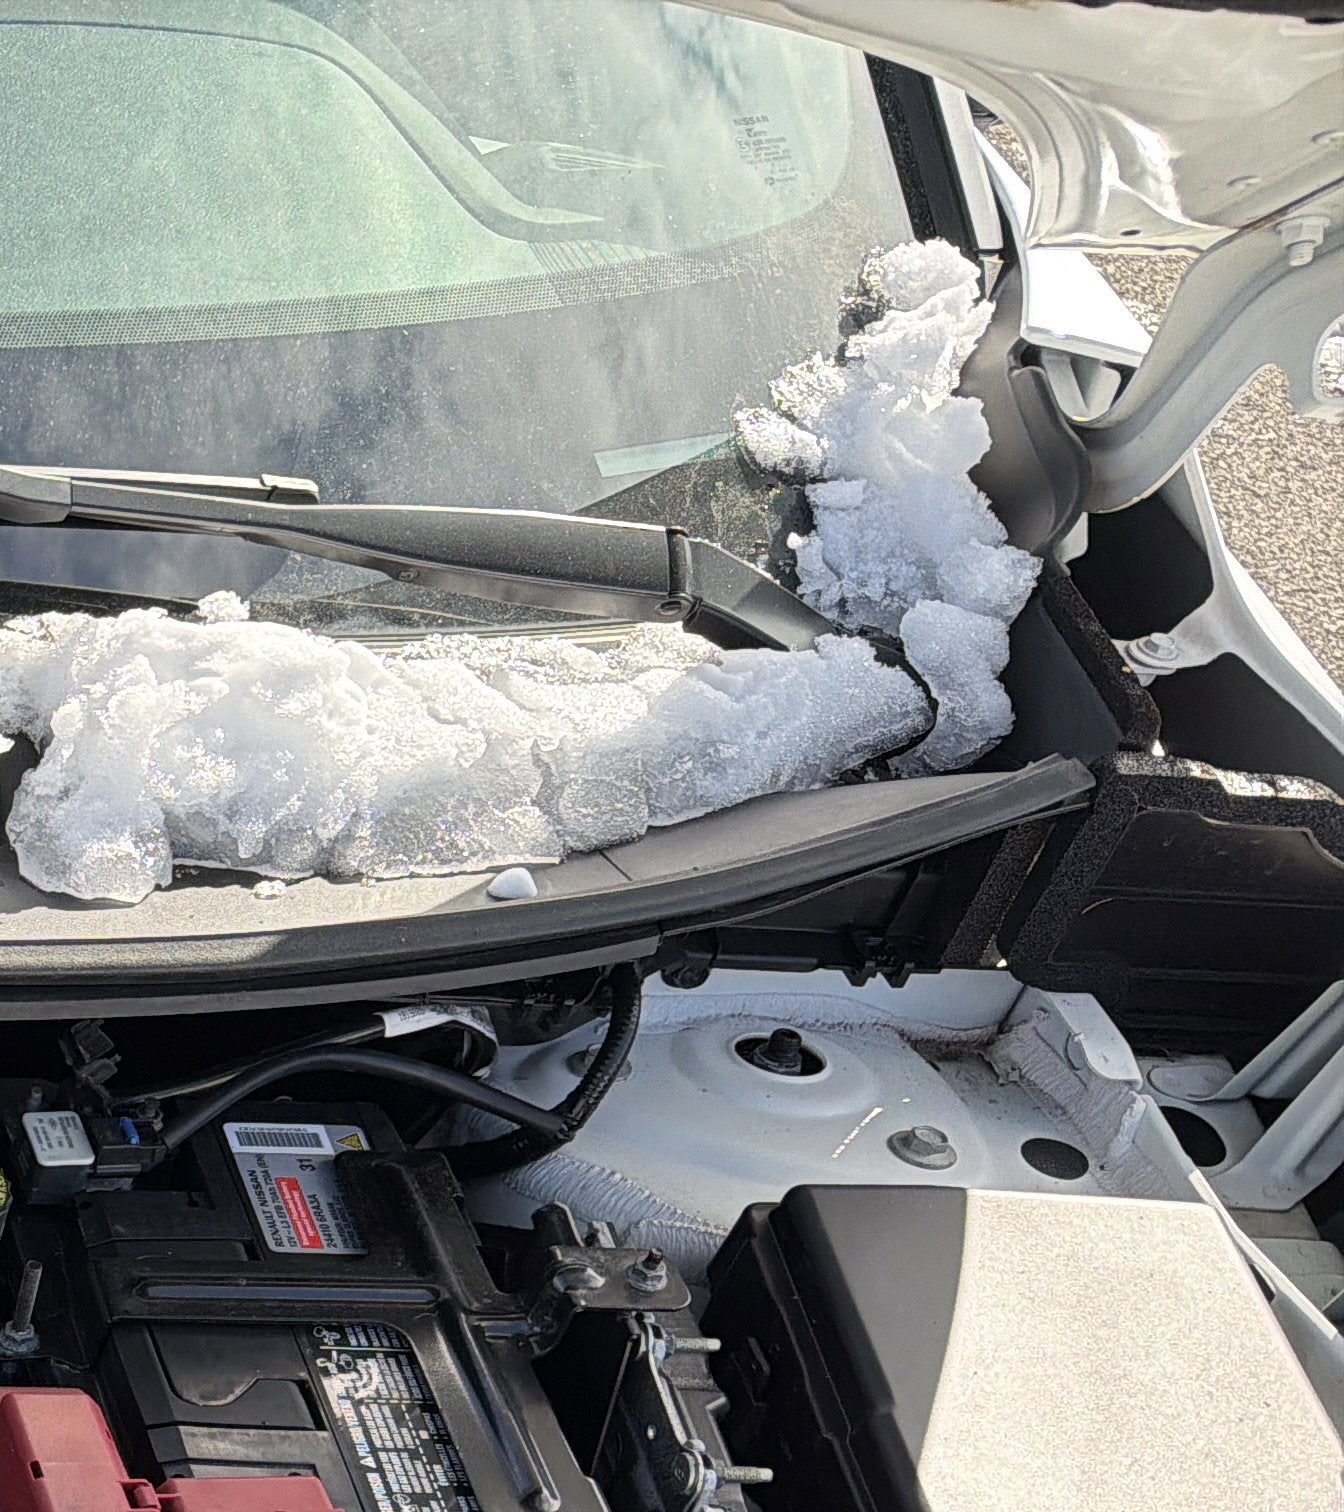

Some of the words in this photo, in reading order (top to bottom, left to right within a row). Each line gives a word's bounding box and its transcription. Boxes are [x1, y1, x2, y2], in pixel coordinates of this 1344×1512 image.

[297, 1158, 316, 1171] 31
[247, 1170, 269, 1207] NISSAN
[262, 1209, 285, 1247] RENAULT
